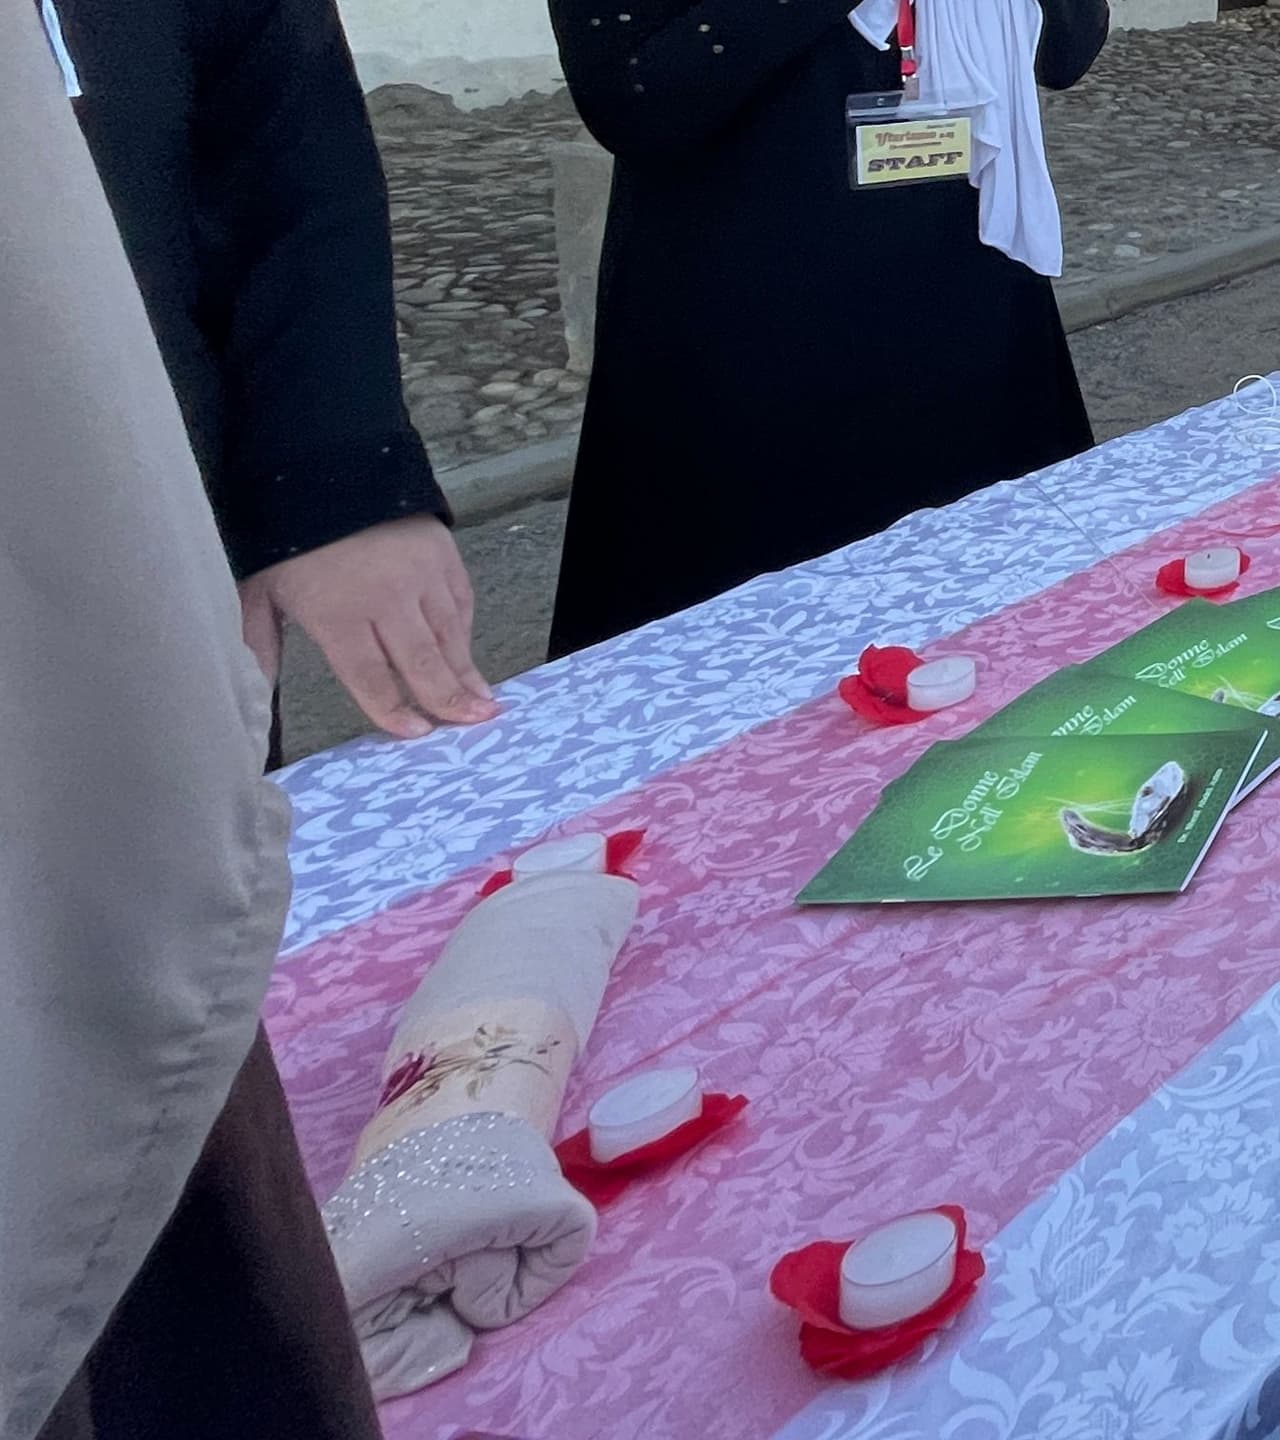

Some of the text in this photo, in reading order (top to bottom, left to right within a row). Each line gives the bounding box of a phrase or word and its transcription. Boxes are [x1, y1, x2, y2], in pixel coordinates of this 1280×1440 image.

[867, 152, 963, 173] STAFF
[1135, 640, 1209, 680] Donne
[930, 770, 999, 840] Donne
